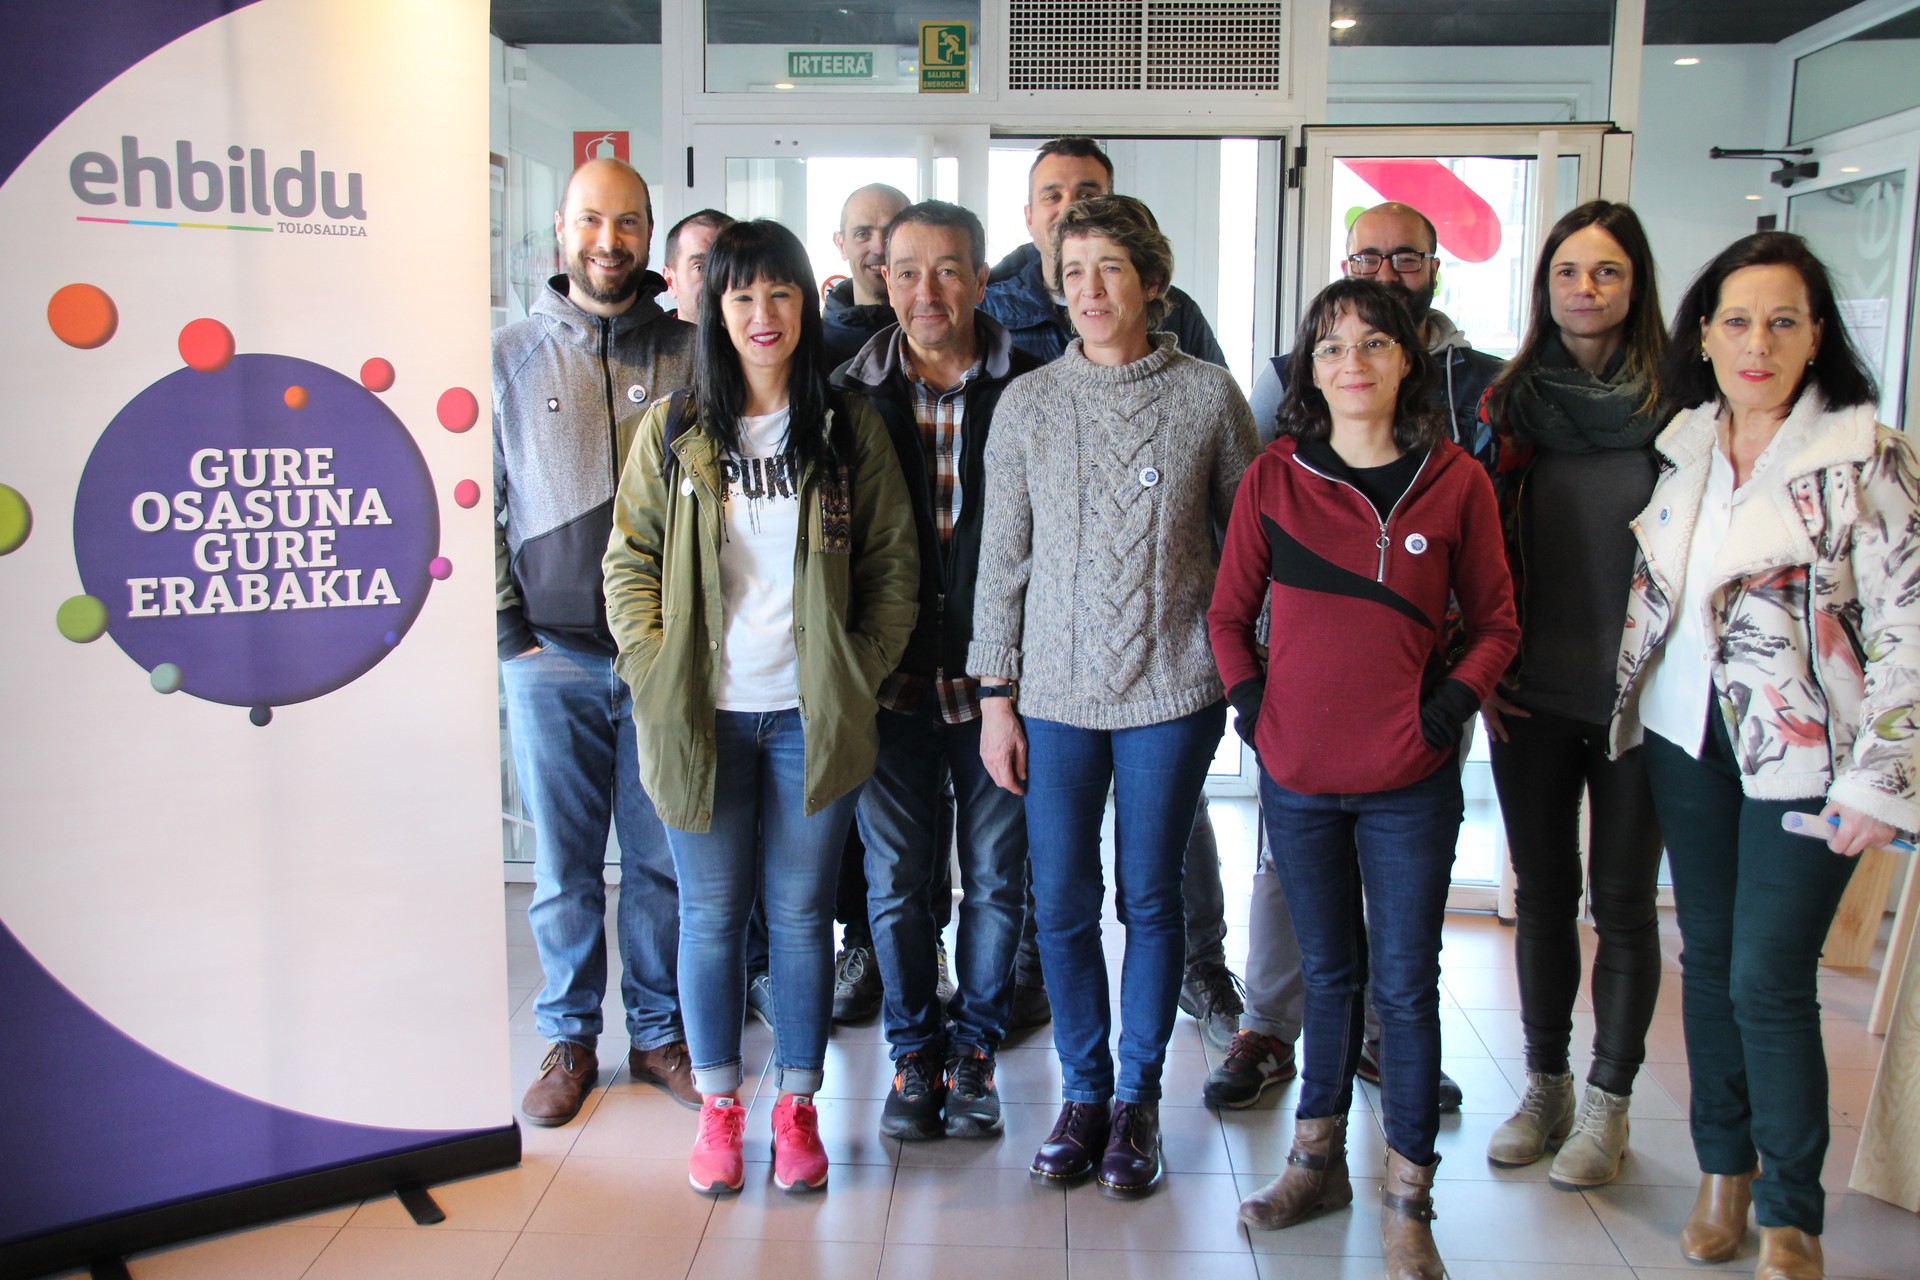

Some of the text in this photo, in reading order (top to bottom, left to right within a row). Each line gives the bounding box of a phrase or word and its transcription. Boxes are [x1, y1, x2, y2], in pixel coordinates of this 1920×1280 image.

[792, 56, 868, 74] IRTEERA
[923, 80, 965, 88] EMERGENCIA
[927, 71, 961, 79] SALIDA DE
[69, 135, 368, 221] ehbildu
[277, 222, 368, 237] TOLOSALDEA
[190, 447, 335, 488] GURE
[131, 487, 393, 532] OSASUNA
[193, 529, 338, 573] GURE
[126, 567, 401, 618] ERABAKIA
